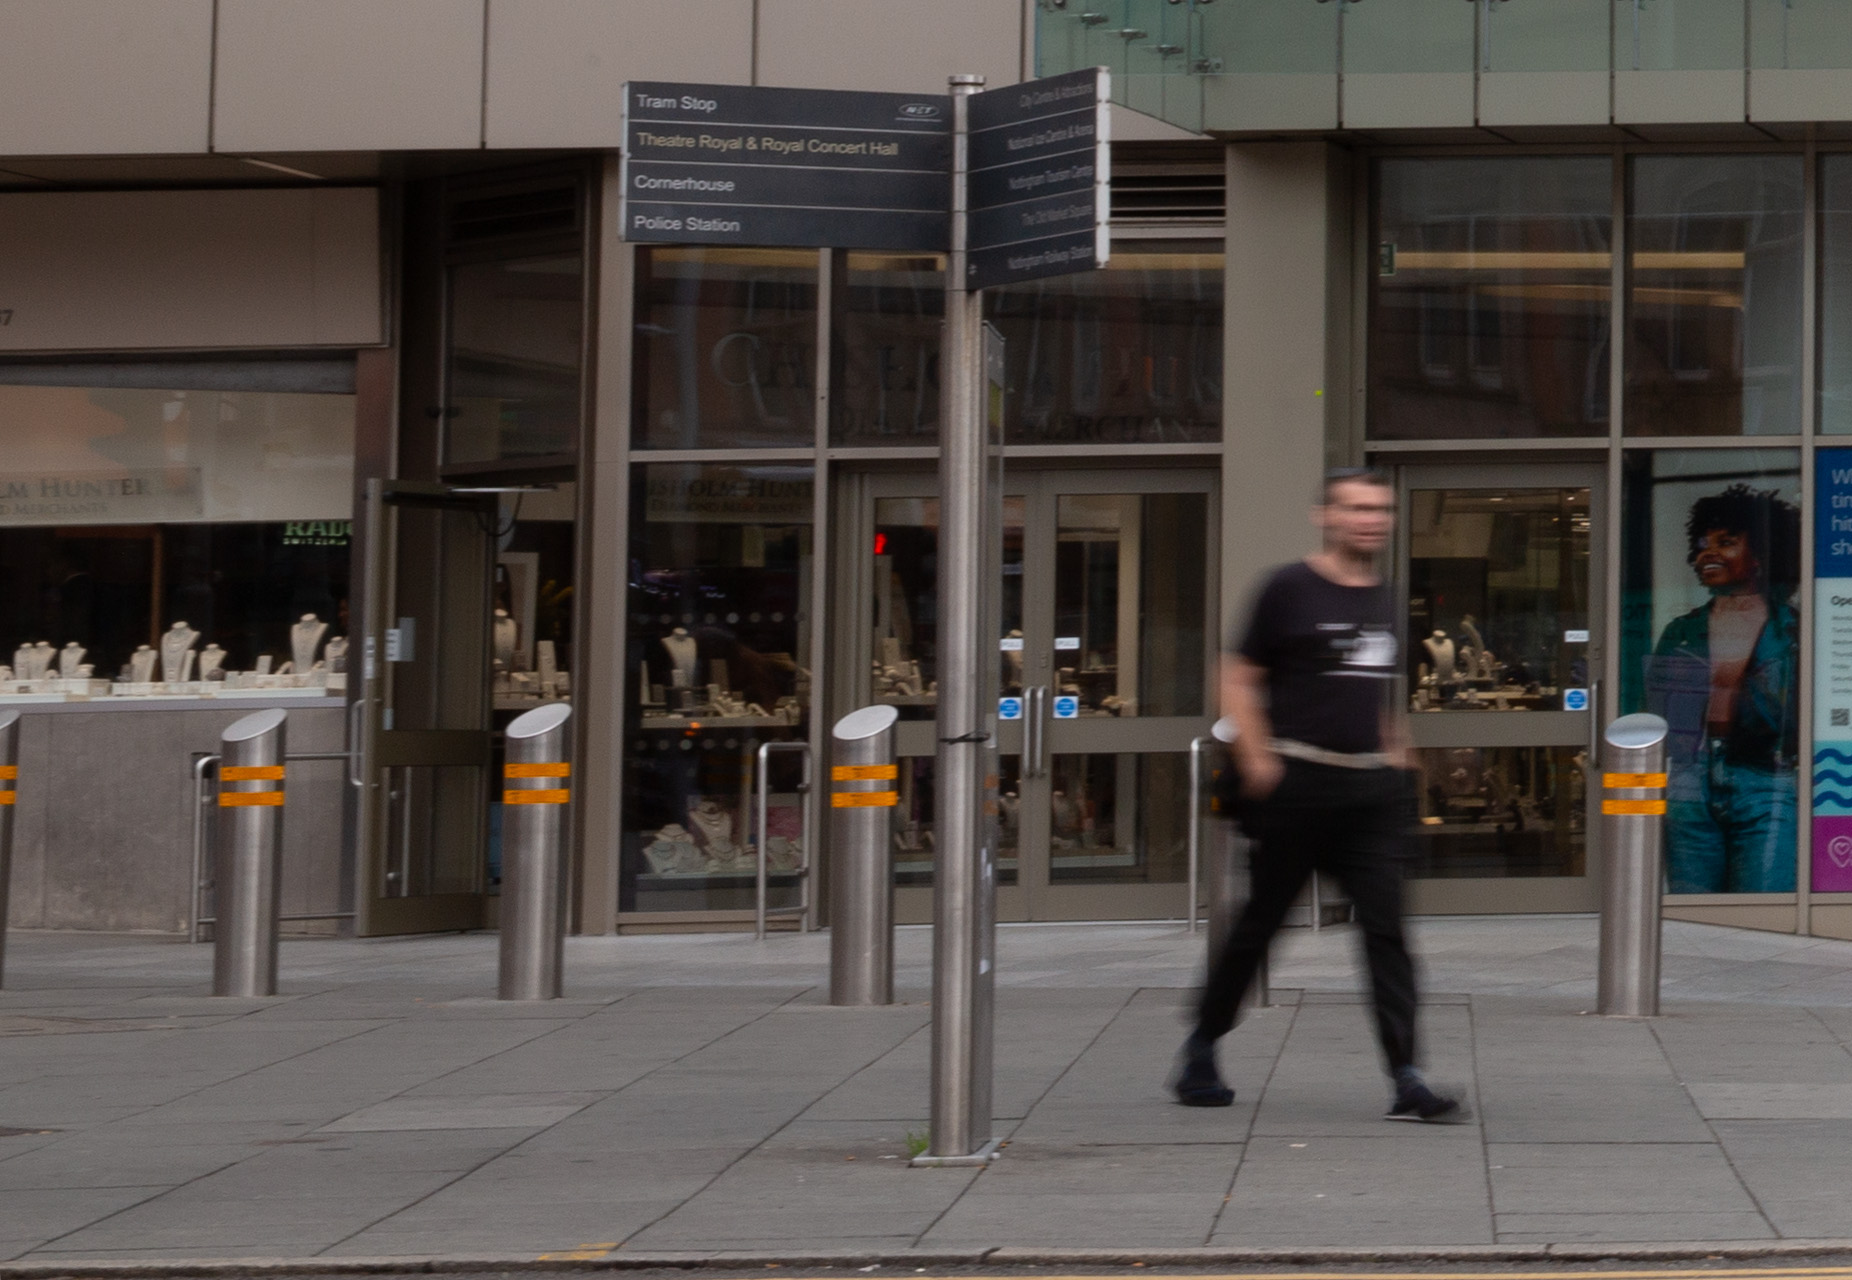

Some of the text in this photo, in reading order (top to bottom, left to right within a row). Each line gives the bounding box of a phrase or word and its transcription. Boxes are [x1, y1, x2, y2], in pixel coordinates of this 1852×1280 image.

[636, 94, 718, 113] Tram Stop
[636, 132, 899, 156] Theatre Royal & Royal Concert Hall
[634, 175, 735, 191] Cornerhouse
[634, 216, 740, 232] Police Station
[40, 478, 152, 497] HUNTER
